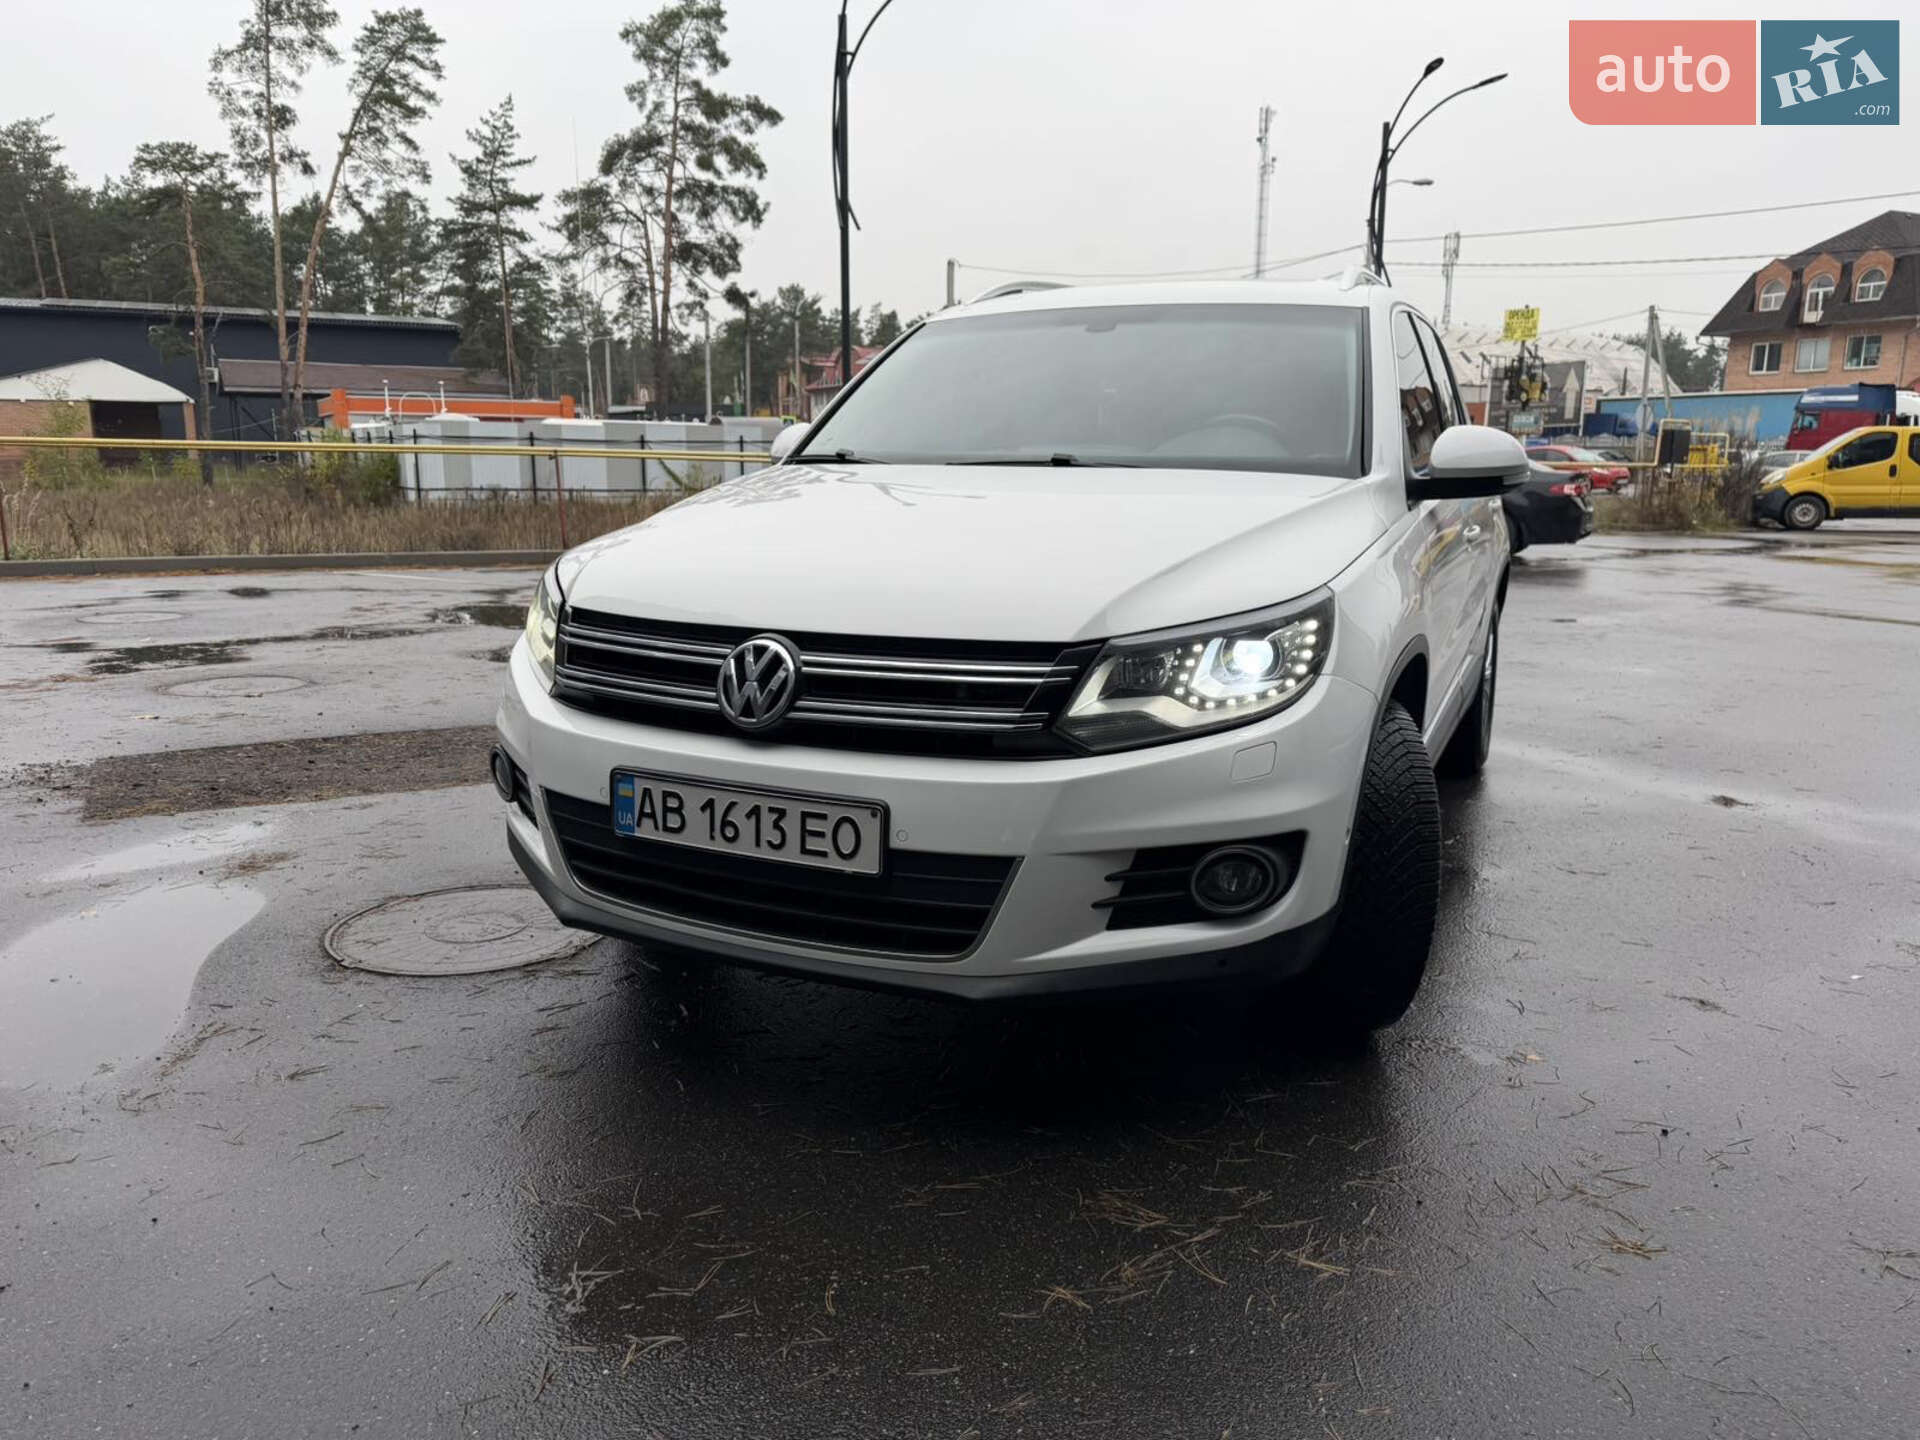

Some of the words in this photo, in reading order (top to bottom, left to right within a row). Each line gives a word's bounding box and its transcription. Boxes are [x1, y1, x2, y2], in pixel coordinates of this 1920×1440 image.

[618, 810, 634, 827] UA
[637, 787, 687, 834] AB
[700, 797, 787, 851] 1613
[800, 811, 862, 860] EO
